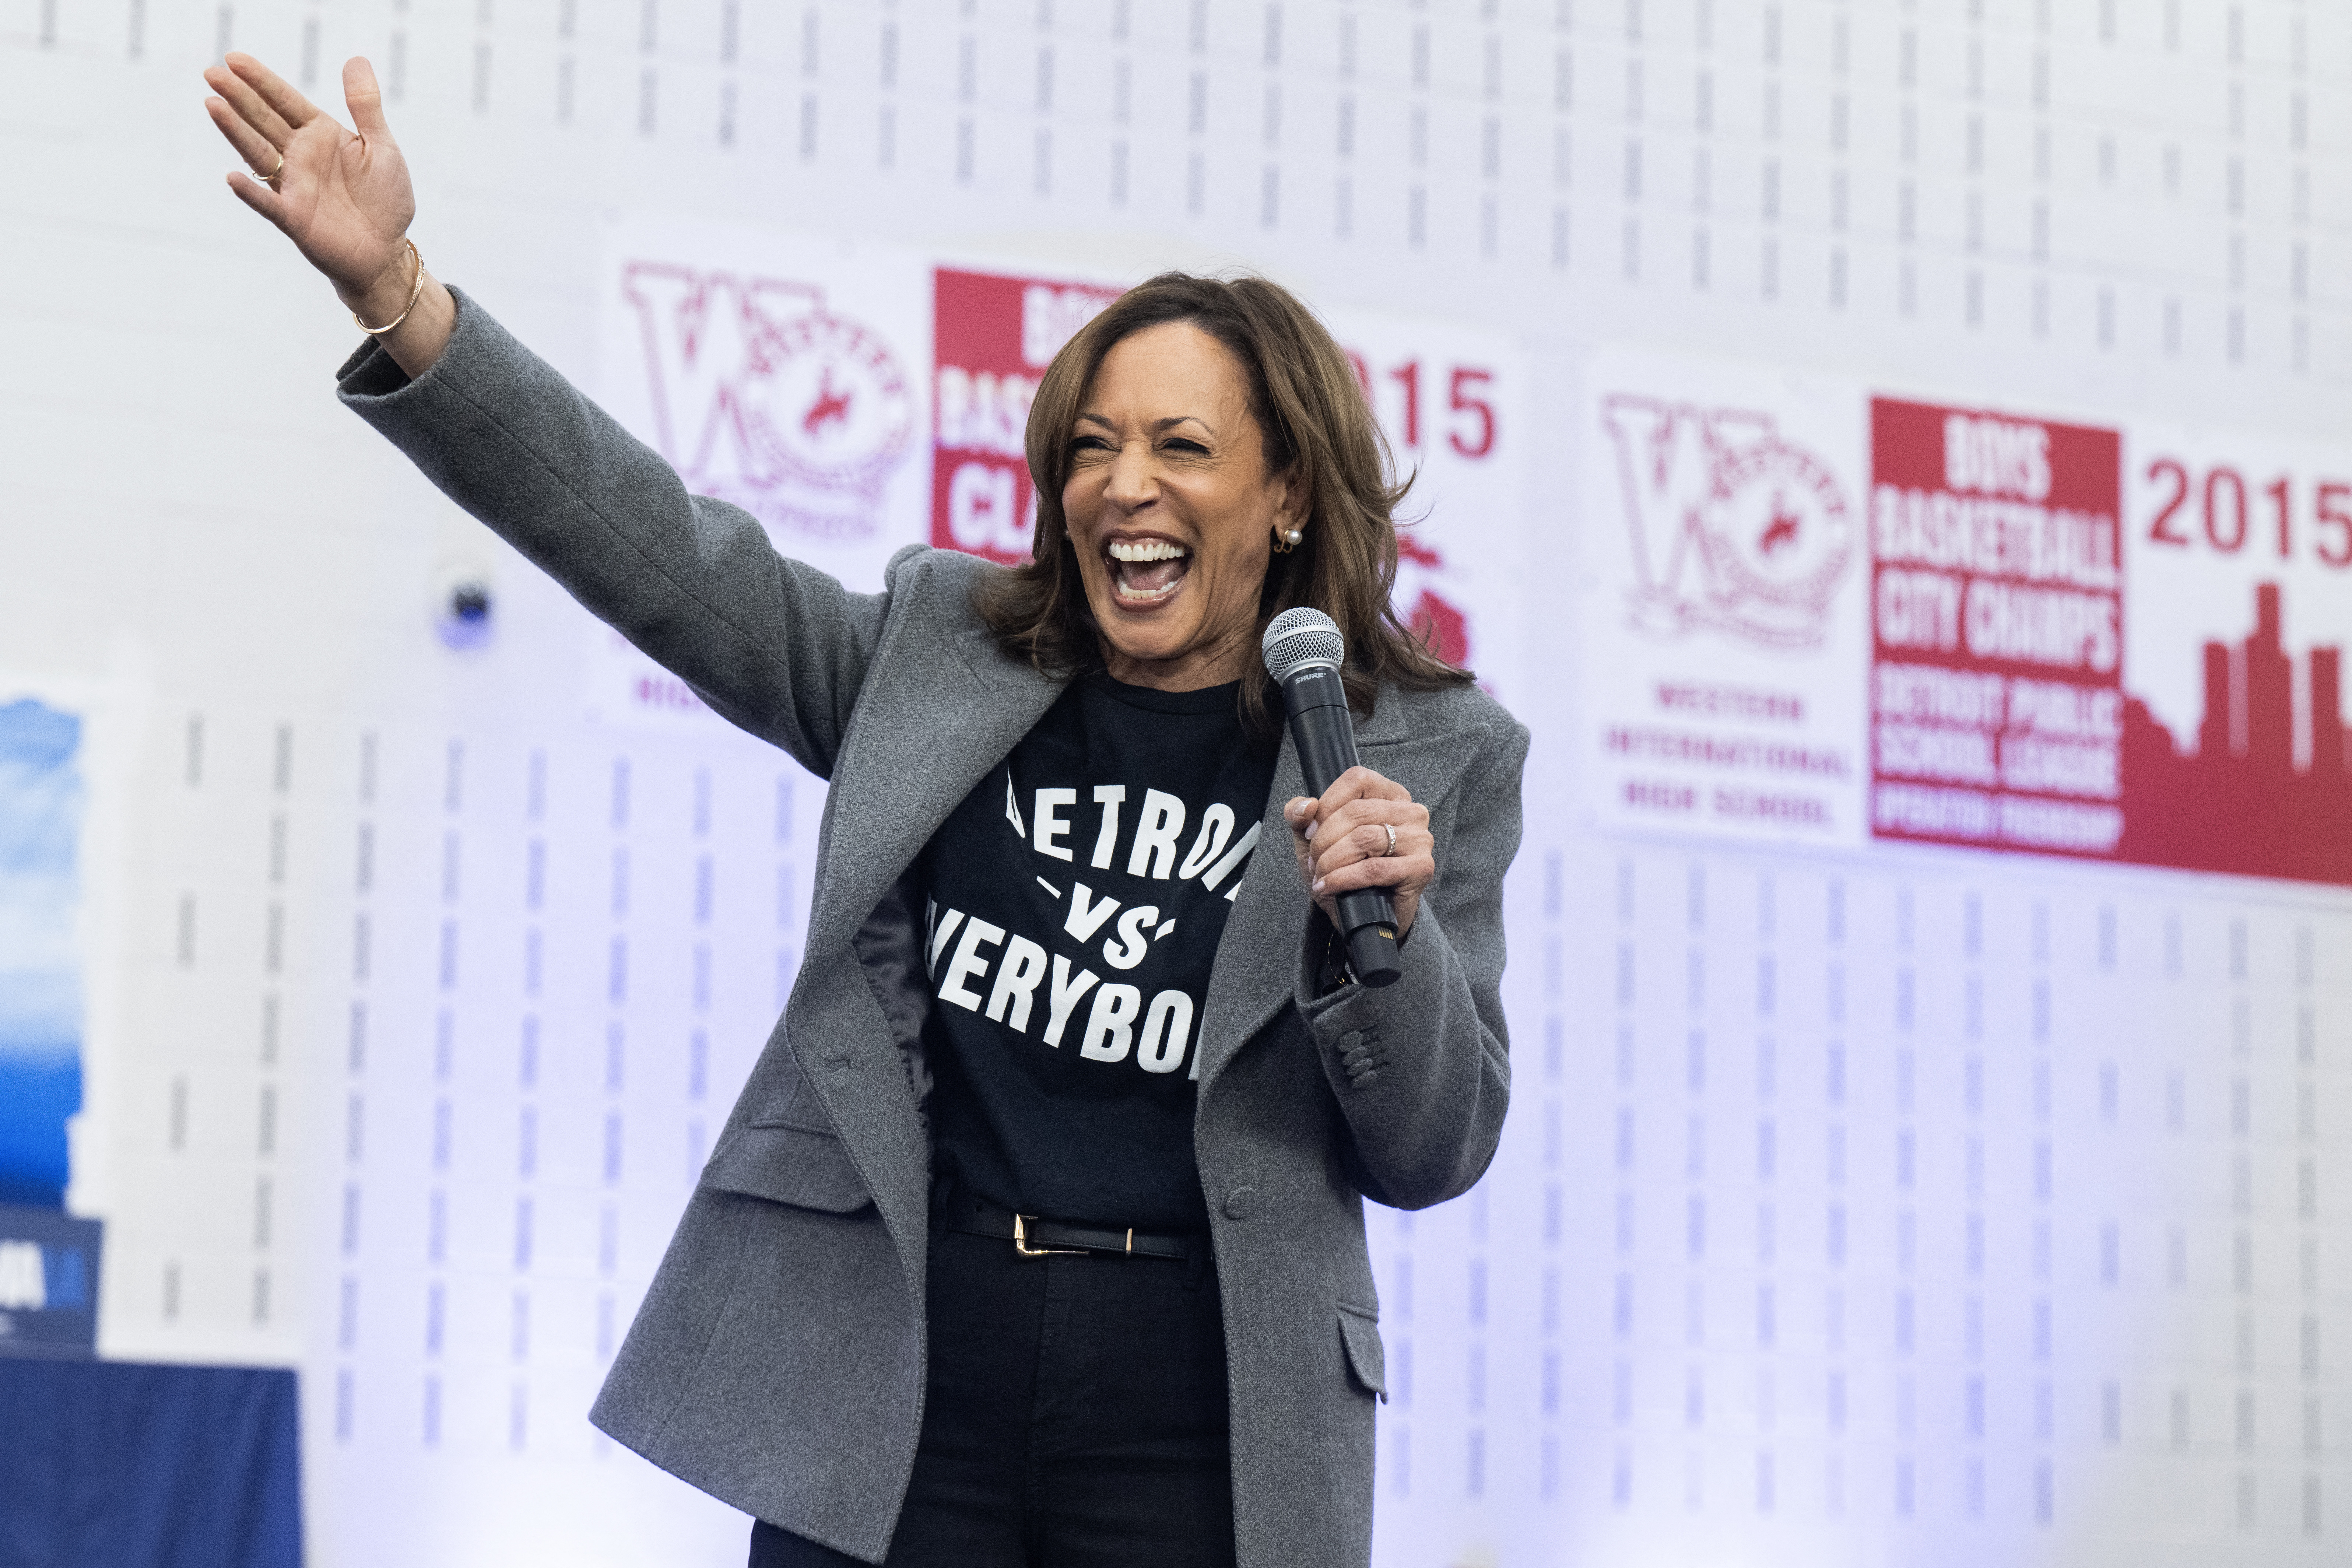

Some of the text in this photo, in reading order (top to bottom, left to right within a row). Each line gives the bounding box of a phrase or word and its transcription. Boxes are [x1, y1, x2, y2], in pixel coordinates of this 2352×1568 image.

[1944, 413, 2051, 500] BOYS
[1876, 484, 2116, 586] BASKETBALL
[2147, 459, 2352, 568] 2015
[1878, 567, 1959, 653] CITY
[1967, 580, 2117, 673] CHAMPS
[1295, 672, 1324, 684] SHURE
[1878, 662, 2120, 738] DETROIT PUBLIC
[1878, 724, 1993, 783] SCHOOL
[1006, 762, 1263, 902] ETROI
